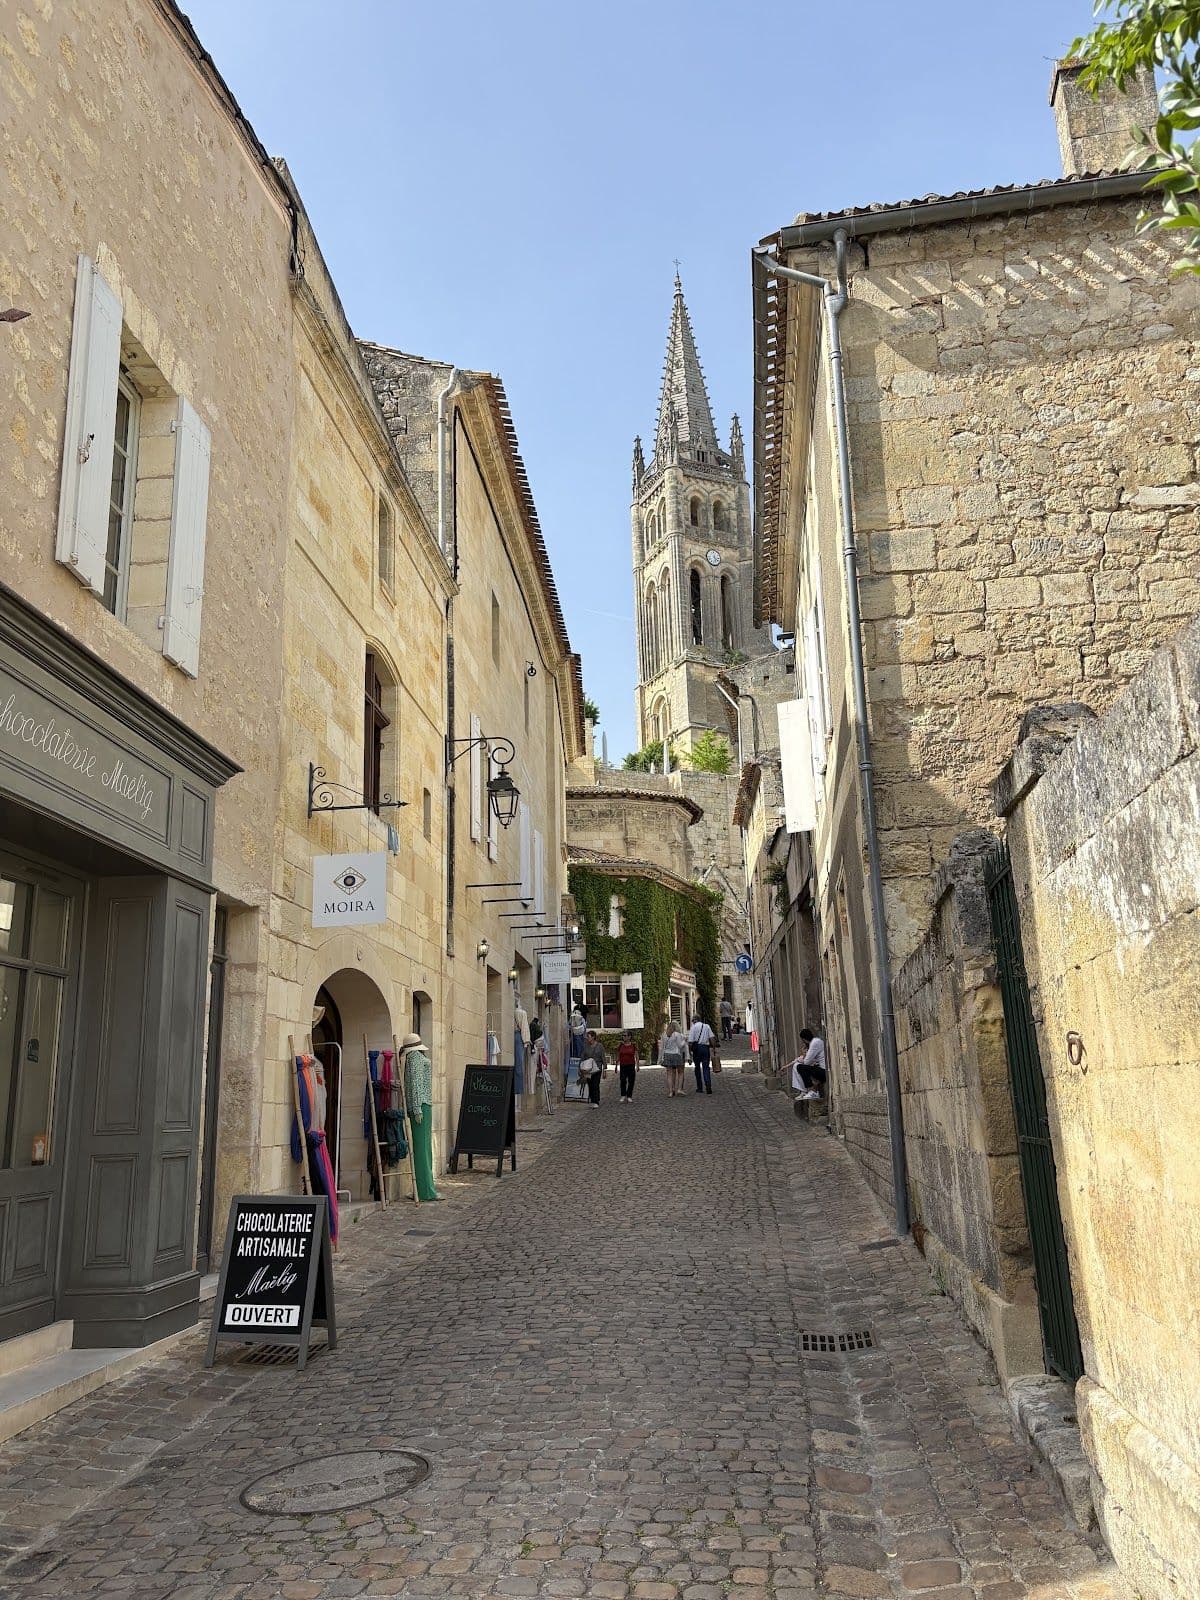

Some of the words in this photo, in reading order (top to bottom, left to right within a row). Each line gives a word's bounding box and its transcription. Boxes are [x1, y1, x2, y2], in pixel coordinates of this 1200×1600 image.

[0, 694, 95, 778] hocolaterie
[323, 901, 375, 914] MOIRA
[236, 1212, 313, 1233] CHOCOLATERIE
[236, 1237, 307, 1258] ARTISANALE
[234, 1262, 298, 1299] Maëlig
[231, 1306, 294, 1324] OUVERT
